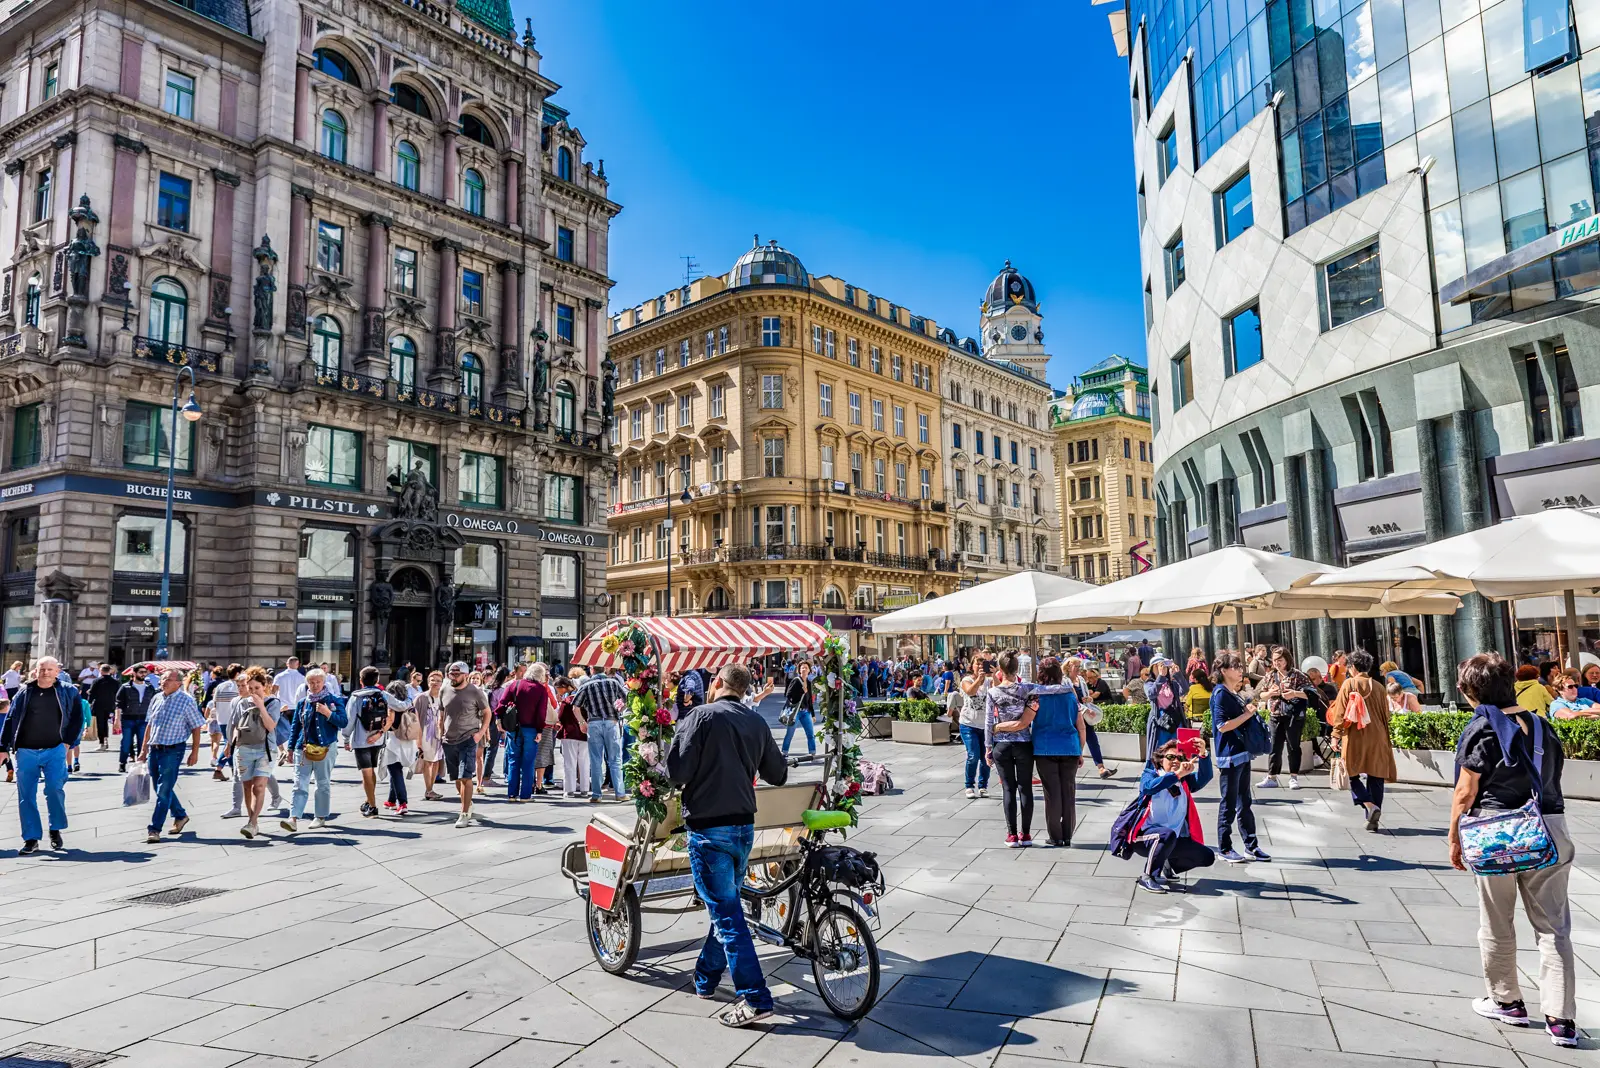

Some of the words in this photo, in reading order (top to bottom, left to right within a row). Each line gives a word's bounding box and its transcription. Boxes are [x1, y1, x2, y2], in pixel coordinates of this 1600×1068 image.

[1, 484, 33, 498] BUCHERER
[289, 495, 360, 514] PILSTL
[462, 518, 504, 532] OMEGA
[547, 532, 583, 545] OMEGA
[311, 594, 344, 602] BUCHERER
[588, 863, 600, 874] CITY
